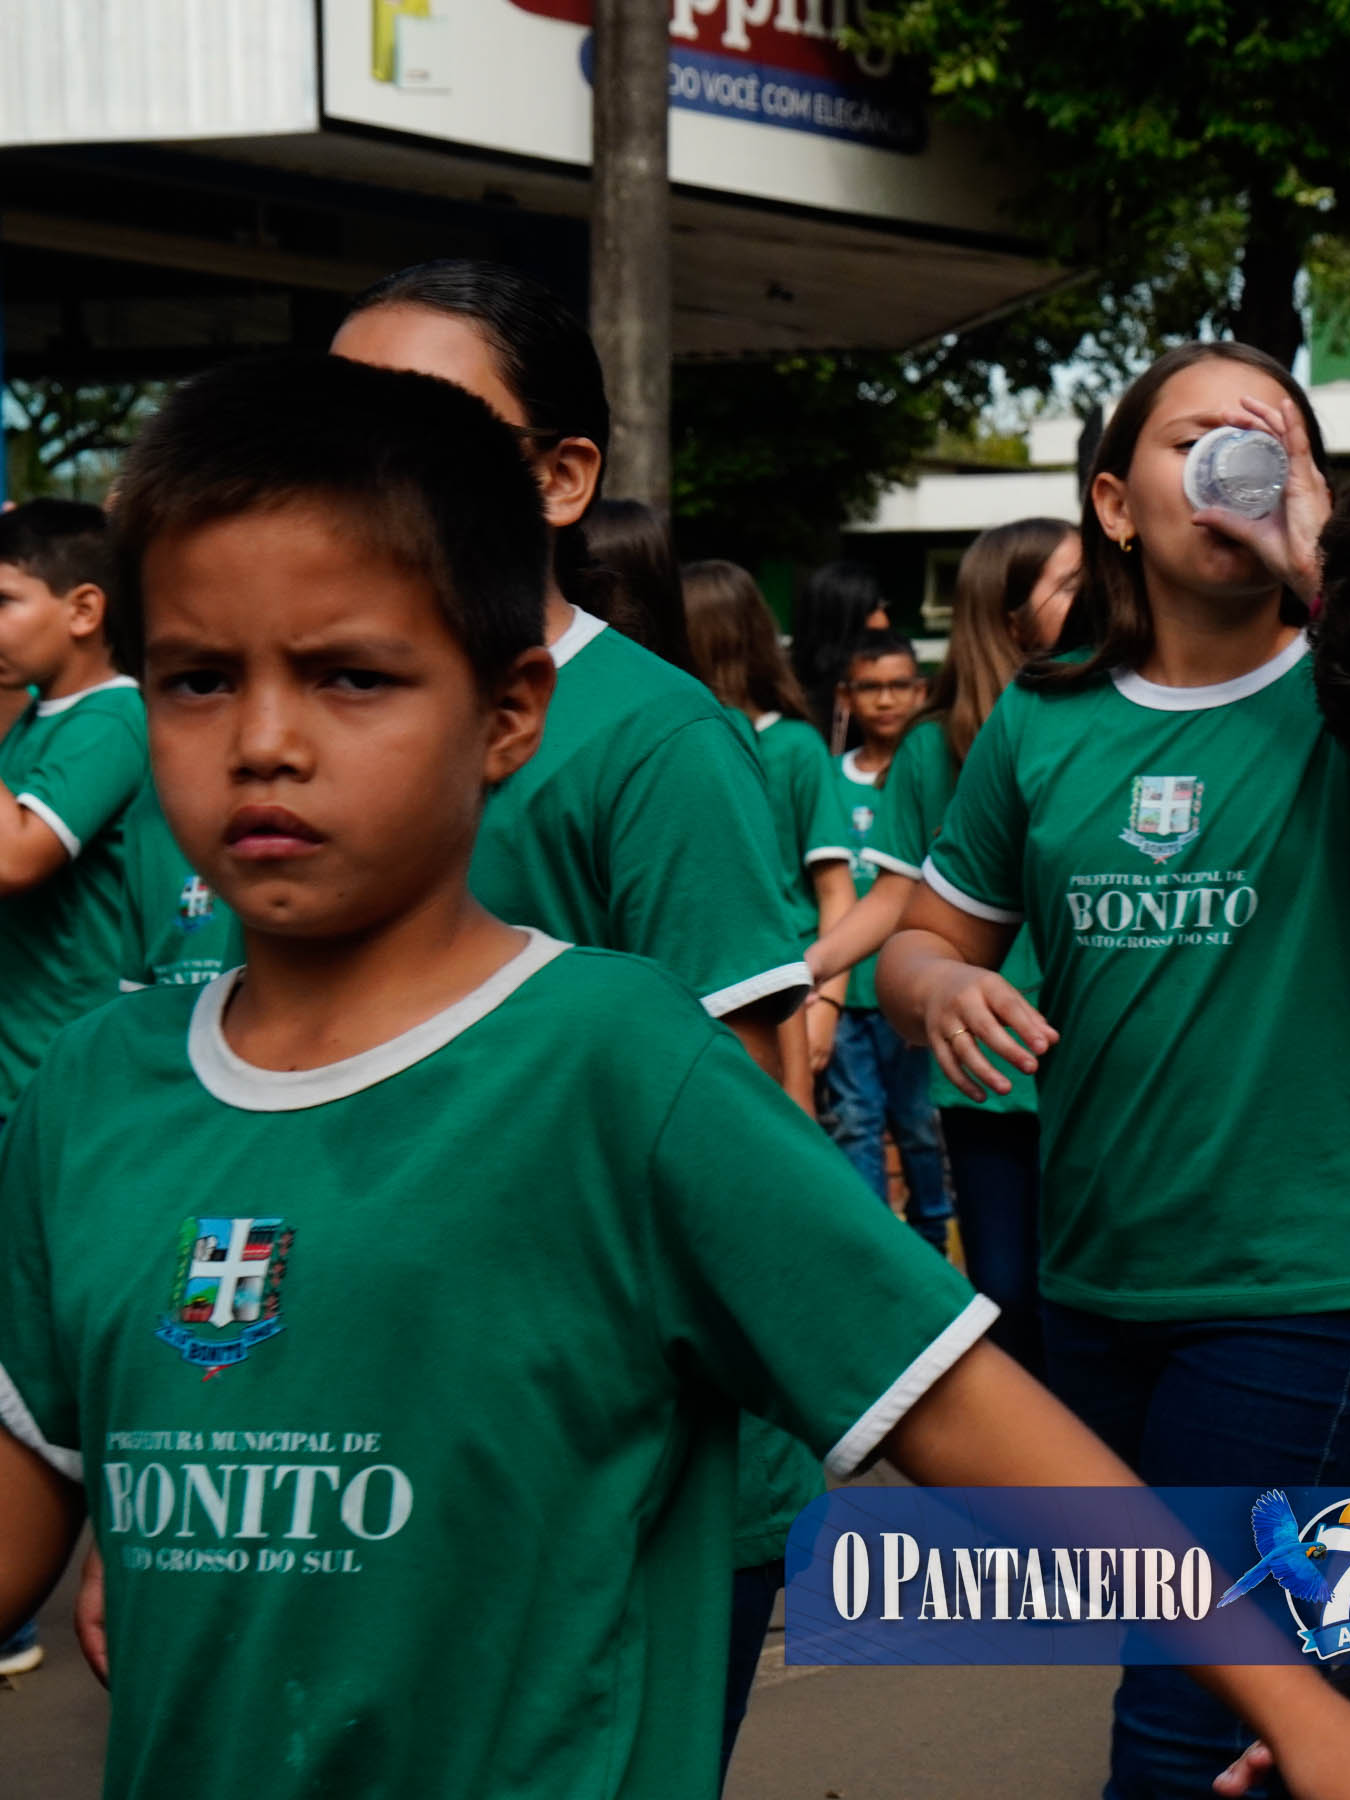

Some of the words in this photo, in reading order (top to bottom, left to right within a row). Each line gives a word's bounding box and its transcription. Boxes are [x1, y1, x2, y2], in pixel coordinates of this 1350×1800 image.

[761, 82, 812, 121] COM
[1226, 870, 1248, 882] DE
[1065, 886, 1259, 932] BONITO
[343, 1432, 382, 1453] DE
[103, 1462, 414, 1541] BONITO
[257, 1548, 296, 1573] DO
[302, 1549, 363, 1574] SUL
